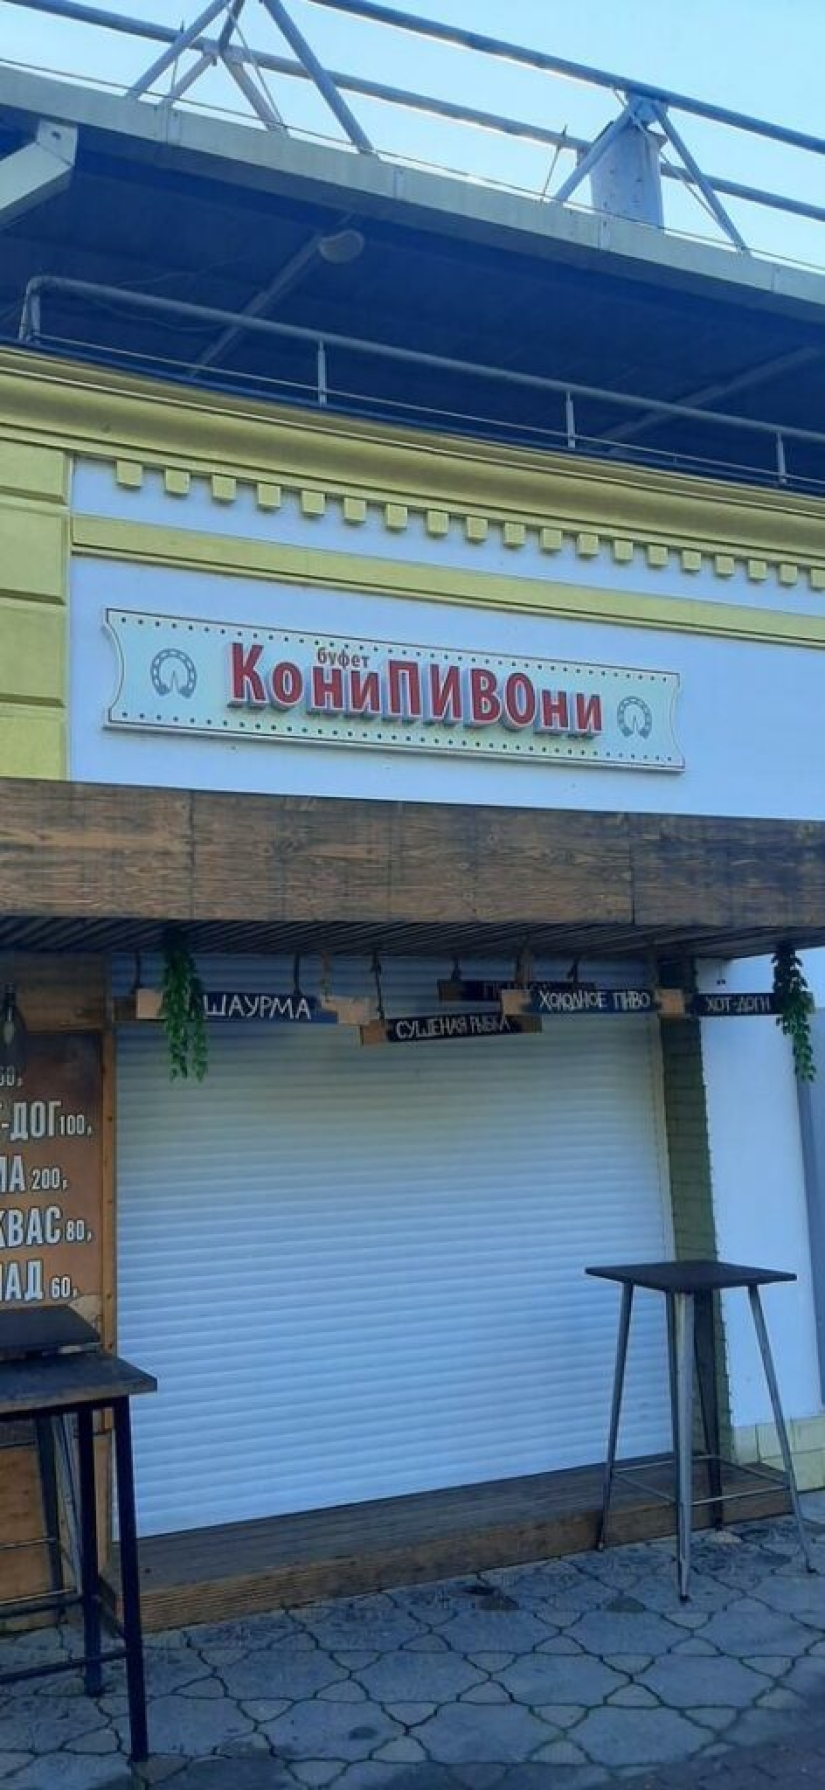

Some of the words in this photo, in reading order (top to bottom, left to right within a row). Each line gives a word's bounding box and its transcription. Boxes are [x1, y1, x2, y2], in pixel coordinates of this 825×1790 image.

[316, 646, 370, 670] буфет
[228, 642, 605, 738] КониПИВОни
[203, 993, 313, 1021] ШАУРМА
[612, 990, 651, 1011] ПИВО
[705, 995, 772, 1013] ХОТ-ДОГИ
